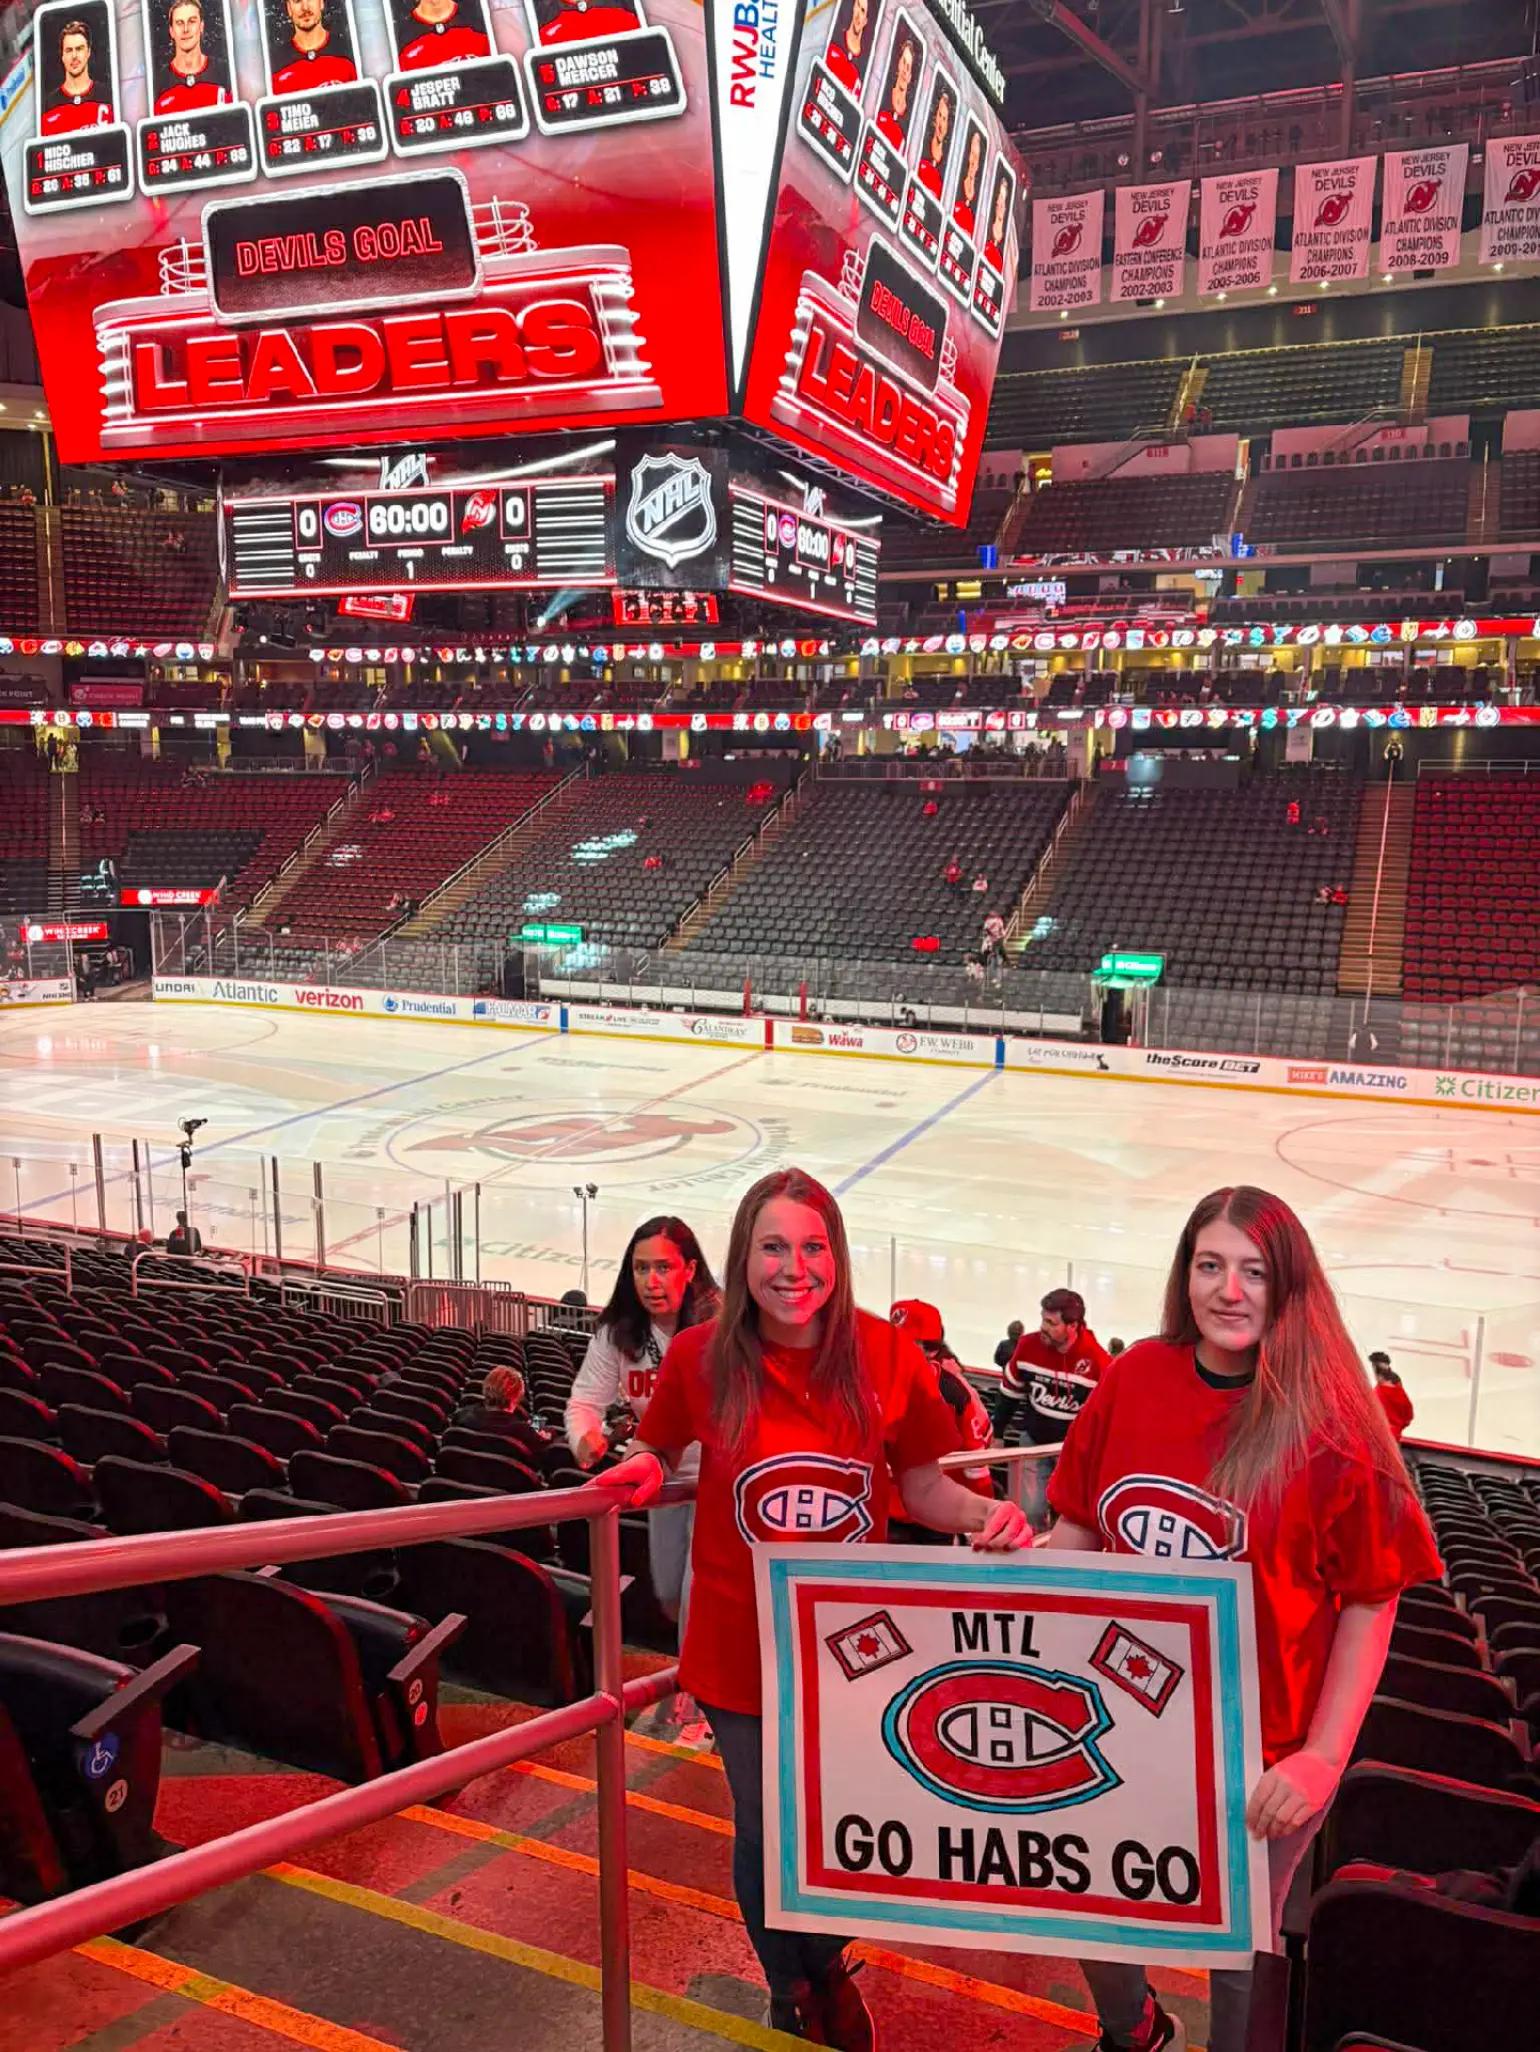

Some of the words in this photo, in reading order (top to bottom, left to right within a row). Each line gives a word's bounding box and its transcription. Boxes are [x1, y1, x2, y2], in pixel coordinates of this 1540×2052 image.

[554, 48, 619, 73] DAWSON
[730, 0, 760, 108] RWJB
[974, 25, 1006, 104] Center
[557, 62, 619, 86] MERCER
[410, 76, 460, 98] JESPER
[413, 90, 456, 111] BRATT
[562, 92, 579, 110] 17
[280, 103, 312, 121] TIMO
[160, 122, 190, 139] JACK
[282, 114, 319, 133] MEIER
[415, 117, 435, 133] 20
[160, 134, 206, 153] HUGHES
[317, 133, 332, 149] 17
[1504, 143, 1522, 153] NEW
[36, 151, 44, 169] 1
[44, 144, 71, 159] NICO
[1401, 156, 1419, 166] NEW
[1420, 152, 1451, 164] JERSEY
[44, 152, 95, 172] HISCHIER
[194, 153, 211, 169] 44
[1312, 169, 1330, 178] NEW
[1404, 164, 1446, 178] DEVILS
[1314, 176, 1355, 191] DEVILS
[1219, 187, 1259, 203] DEVILS
[1132, 200, 1170, 213] DEVILS
[1051, 211, 1086, 224] DEVILS
[1384, 219, 1421, 235] ATLANTIC
[1423, 216, 1458, 232] DIVISION
[1485, 208, 1524, 225] ATLANTIC
[237, 228, 346, 275] DEVILS
[353, 217, 443, 259] GOAL
[1294, 231, 1332, 247] ATLANTIC
[1333, 227, 1368, 244] DIVISION
[1396, 235, 1443, 252] CHAMPIONS
[1115, 250, 1142, 266] EASTERN
[1143, 246, 1183, 262] CONFERENCE
[1202, 243, 1238, 260] ATLANTIC
[1239, 238, 1272, 254] DIVISION
[1307, 246, 1354, 263] CHAMPIONS
[1034, 260, 1067, 276] ATLANTIC
[1068, 257, 1100, 274] DIVISION
[1212, 256, 1258, 275] CHAMPIONS
[1388, 252, 1449, 268] 2008-2009
[1121, 265, 1174, 282] CHAMPIONS
[1300, 263, 1357, 279] 2006-2007
[1044, 278, 1087, 292] CHAMPIONS
[1120, 282, 1173, 297] 2002-2003
[1207, 273, 1261, 291] 2005-2006
[1037, 291, 1093, 307] 2002-2003
[871, 280, 910, 336] DEVILS
[908, 311, 935, 360] GOAL
[136, 300, 600, 410] LEADERS
[801, 325, 956, 478] LEADERS
[643, 470, 700, 533] NHL
[299, 510, 316, 537] 0
[369, 502, 448, 535] 60:00
[505, 496, 524, 526] 0
[767, 513, 777, 541] 0
[845, 543, 854, 570] 0
[305, 563, 315, 578] 0
[406, 560, 415, 580] 1
[511, 553, 523, 570] 0
[213, 981, 278, 1003] Atlantic
[295, 988, 364, 1010] verizon
[402, 1000, 457, 1015] Prudential
[940, 1038, 974, 1050] WEBB
[1147, 1053, 1218, 1068] theScore
[1330, 1070, 1407, 1089] AMAZING
[952, 1611, 1040, 1658] MTL
[108, 1783, 124, 1807] 21
[835, 1813, 913, 1876] GO
[938, 1826, 1091, 1893] HABS
[1111, 1839, 1201, 1905] GO
